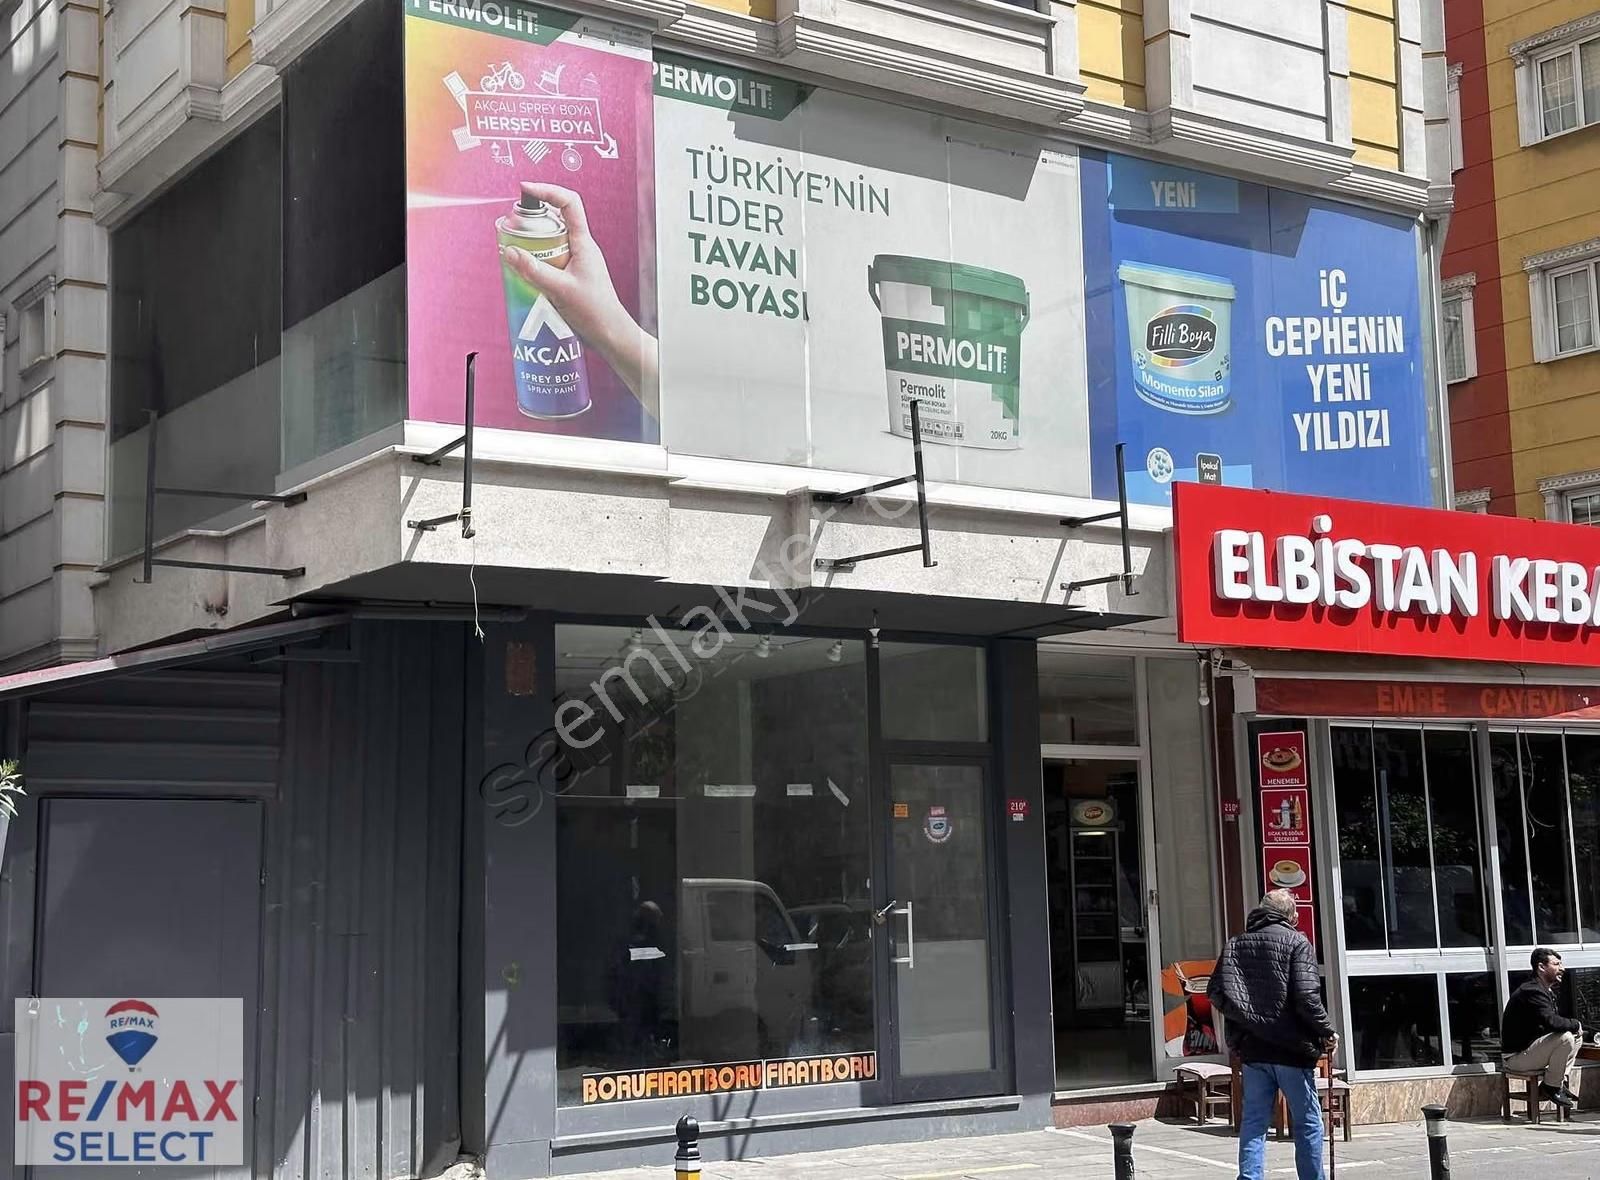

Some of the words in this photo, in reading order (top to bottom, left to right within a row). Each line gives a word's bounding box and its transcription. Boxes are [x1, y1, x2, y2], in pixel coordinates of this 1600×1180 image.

[474, 100, 516, 113] AKÇALI
[519, 102, 556, 115] SPREY
[560, 105, 592, 116] BOYA
[477, 116, 546, 134] HERŞEYİ
[550, 119, 594, 135] BOYA
[688, 184, 785, 236] LİDER
[688, 232, 797, 280] TAVAN
[690, 274, 809, 322] BOYASI
[1152, 323, 1176, 348] Filli
[1179, 322, 1213, 351] Boya
[520, 370, 552, 384] SPREY
[555, 370, 581, 384] BOYA
[527, 384, 552, 394] SPRAY
[554, 384, 577, 394] PAINT
[900, 378, 946, 399] Permolit
[1141, 371, 1198, 398] Momento
[1198, 385, 1224, 398] Silan
[1292, 409, 1391, 453] YILDIZI
[1214, 513, 1479, 618] ELBİSTAN
